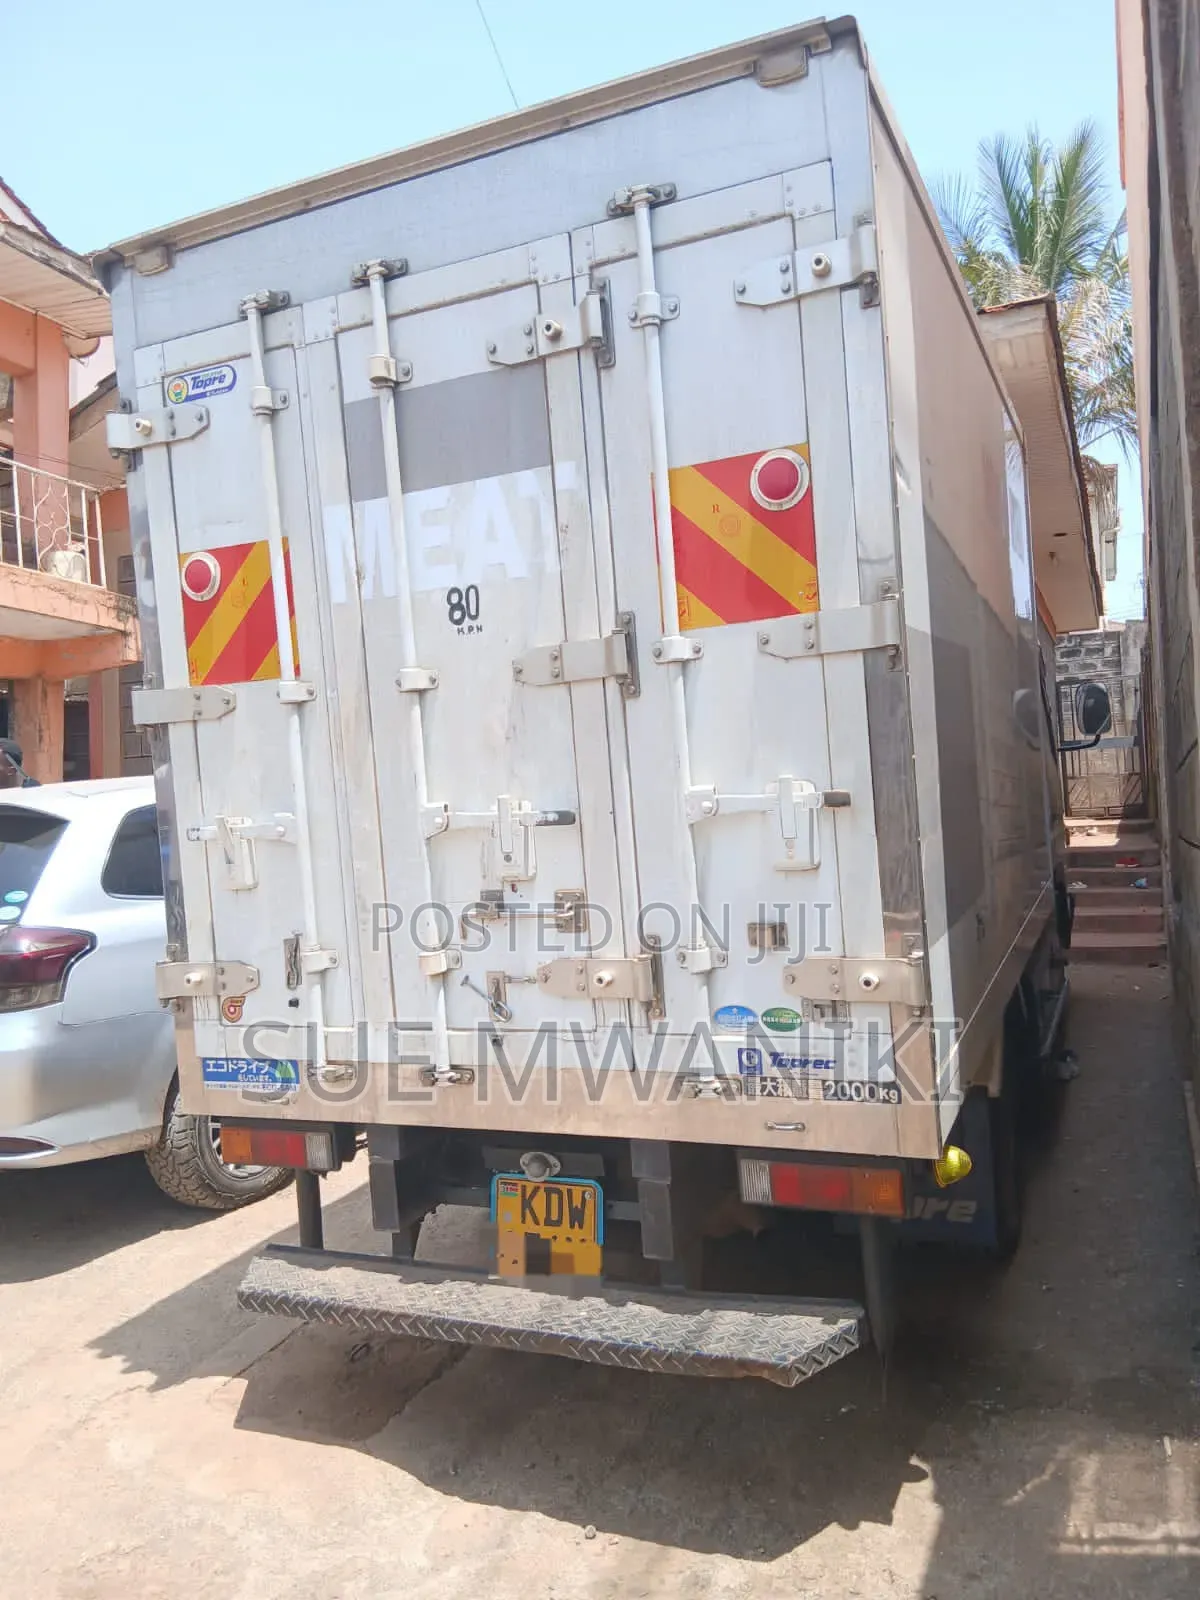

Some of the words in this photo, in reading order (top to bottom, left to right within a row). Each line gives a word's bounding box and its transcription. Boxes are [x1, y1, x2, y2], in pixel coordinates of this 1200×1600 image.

[191, 374, 226, 390] Topre
[323, 461, 577, 604] MEAT
[446, 584, 480, 626] 80
[520, 1184, 588, 1230] KDW
